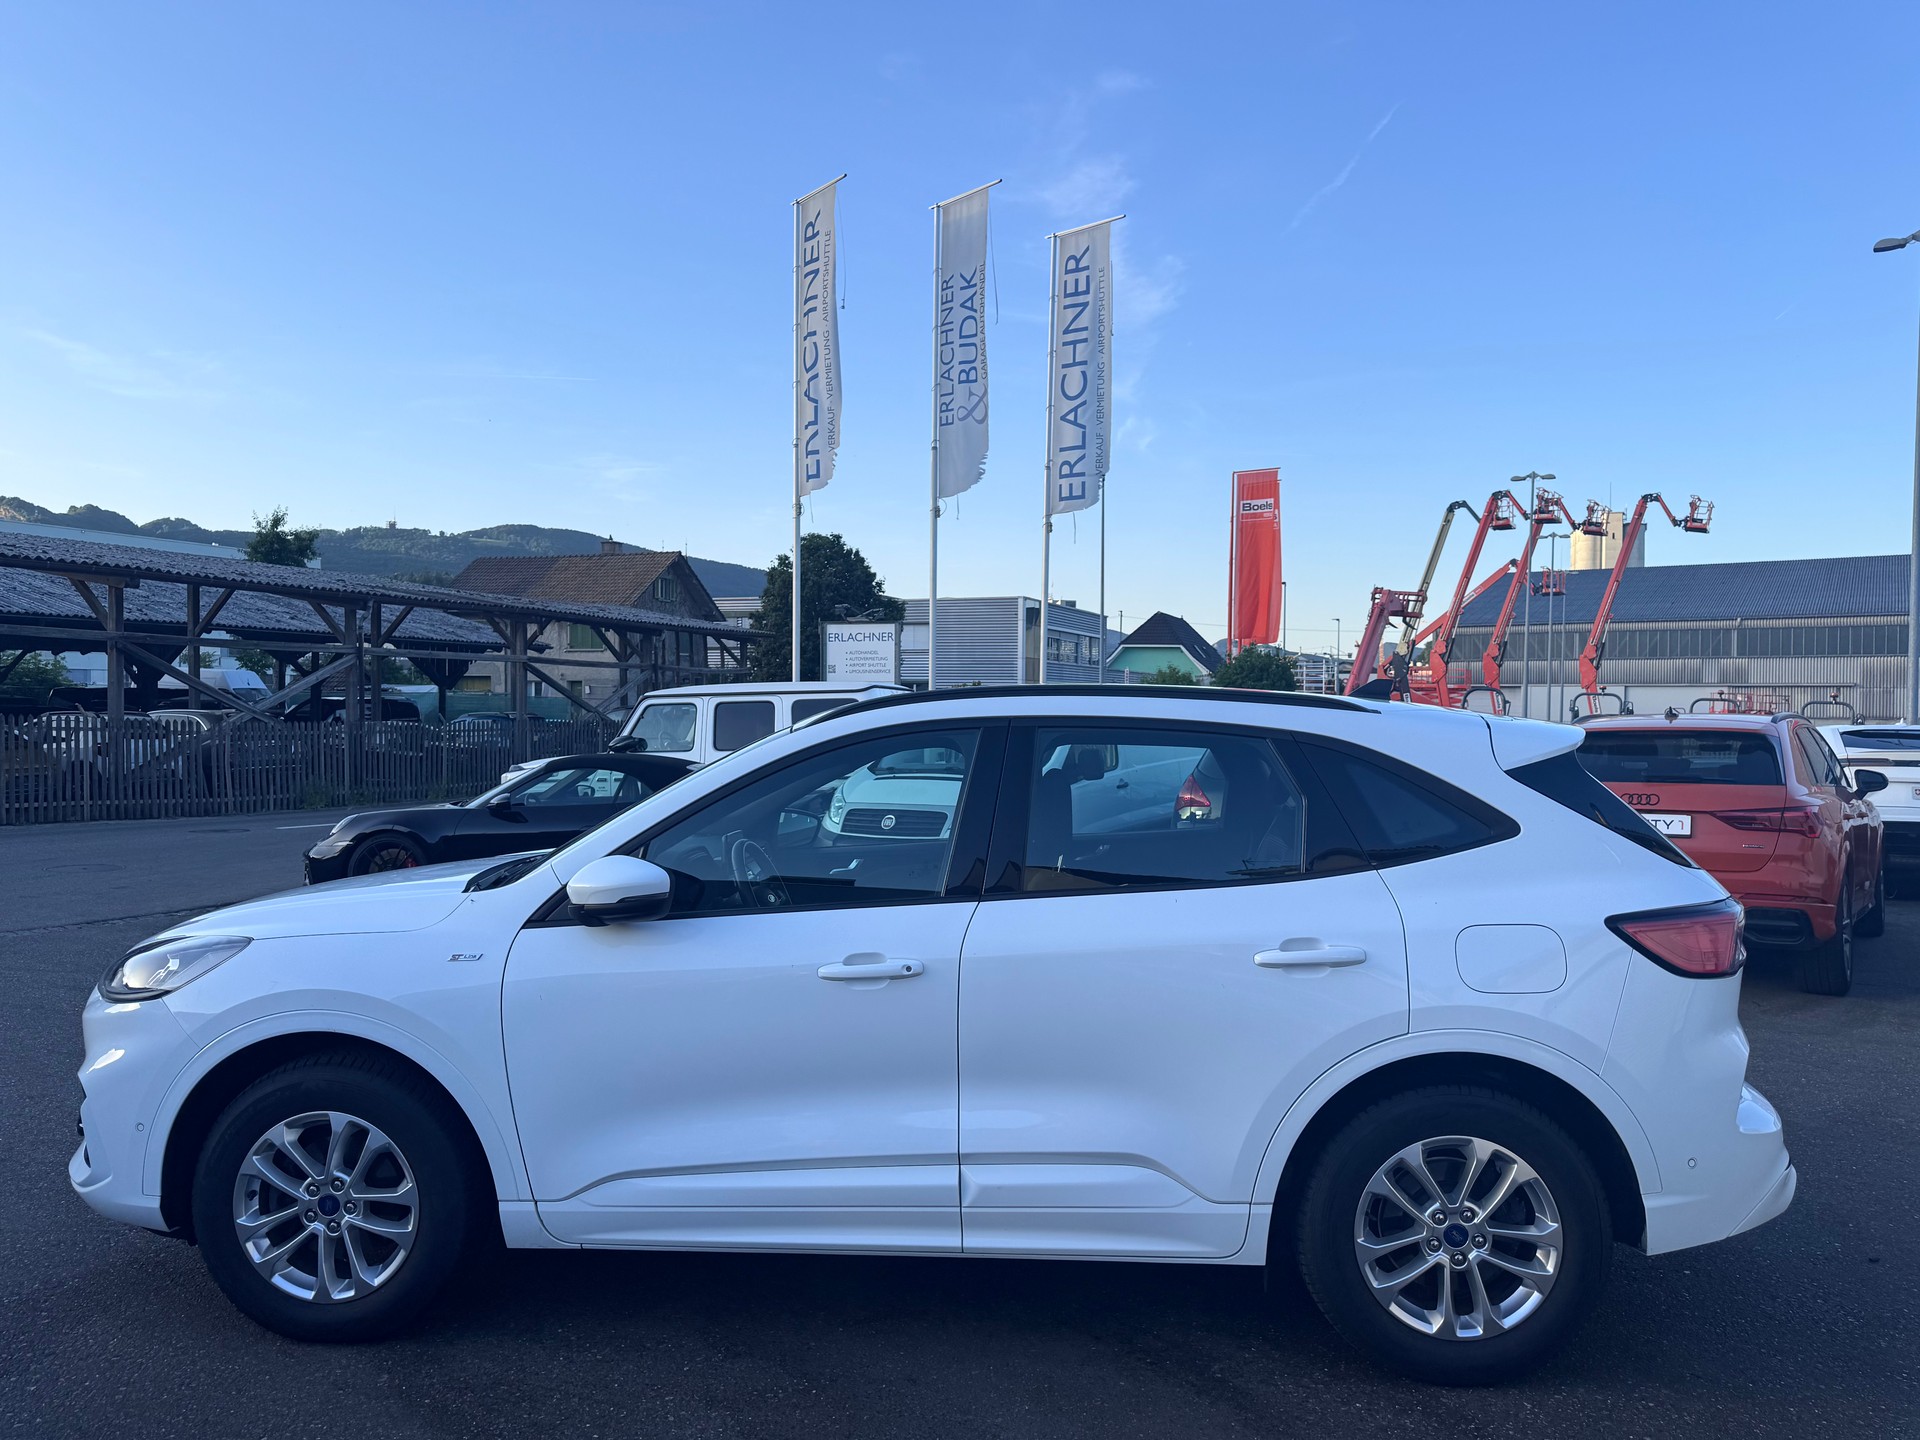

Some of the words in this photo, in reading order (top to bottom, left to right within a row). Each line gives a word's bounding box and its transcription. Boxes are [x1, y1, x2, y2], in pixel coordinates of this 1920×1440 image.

[822, 229, 831, 322] AIRPORTSHUTTLE
[1098, 266, 1106, 355] AIRPORTSHUTTLE
[803, 208, 821, 483] ERLACHNER
[939, 273, 955, 427] ERLACHNER
[957, 265, 978, 385] BUDAK
[823, 330, 833, 400] VERMIETUNG
[1059, 244, 1091, 503] ERLACHNER
[1095, 361, 1105, 427] VERMIETUNG
[827, 407, 836, 453] VERKAUF
[1095, 432, 1104, 476] VERKAUF
[1242, 501, 1273, 512] Boels
[828, 632, 894, 642] ERLACHNER
